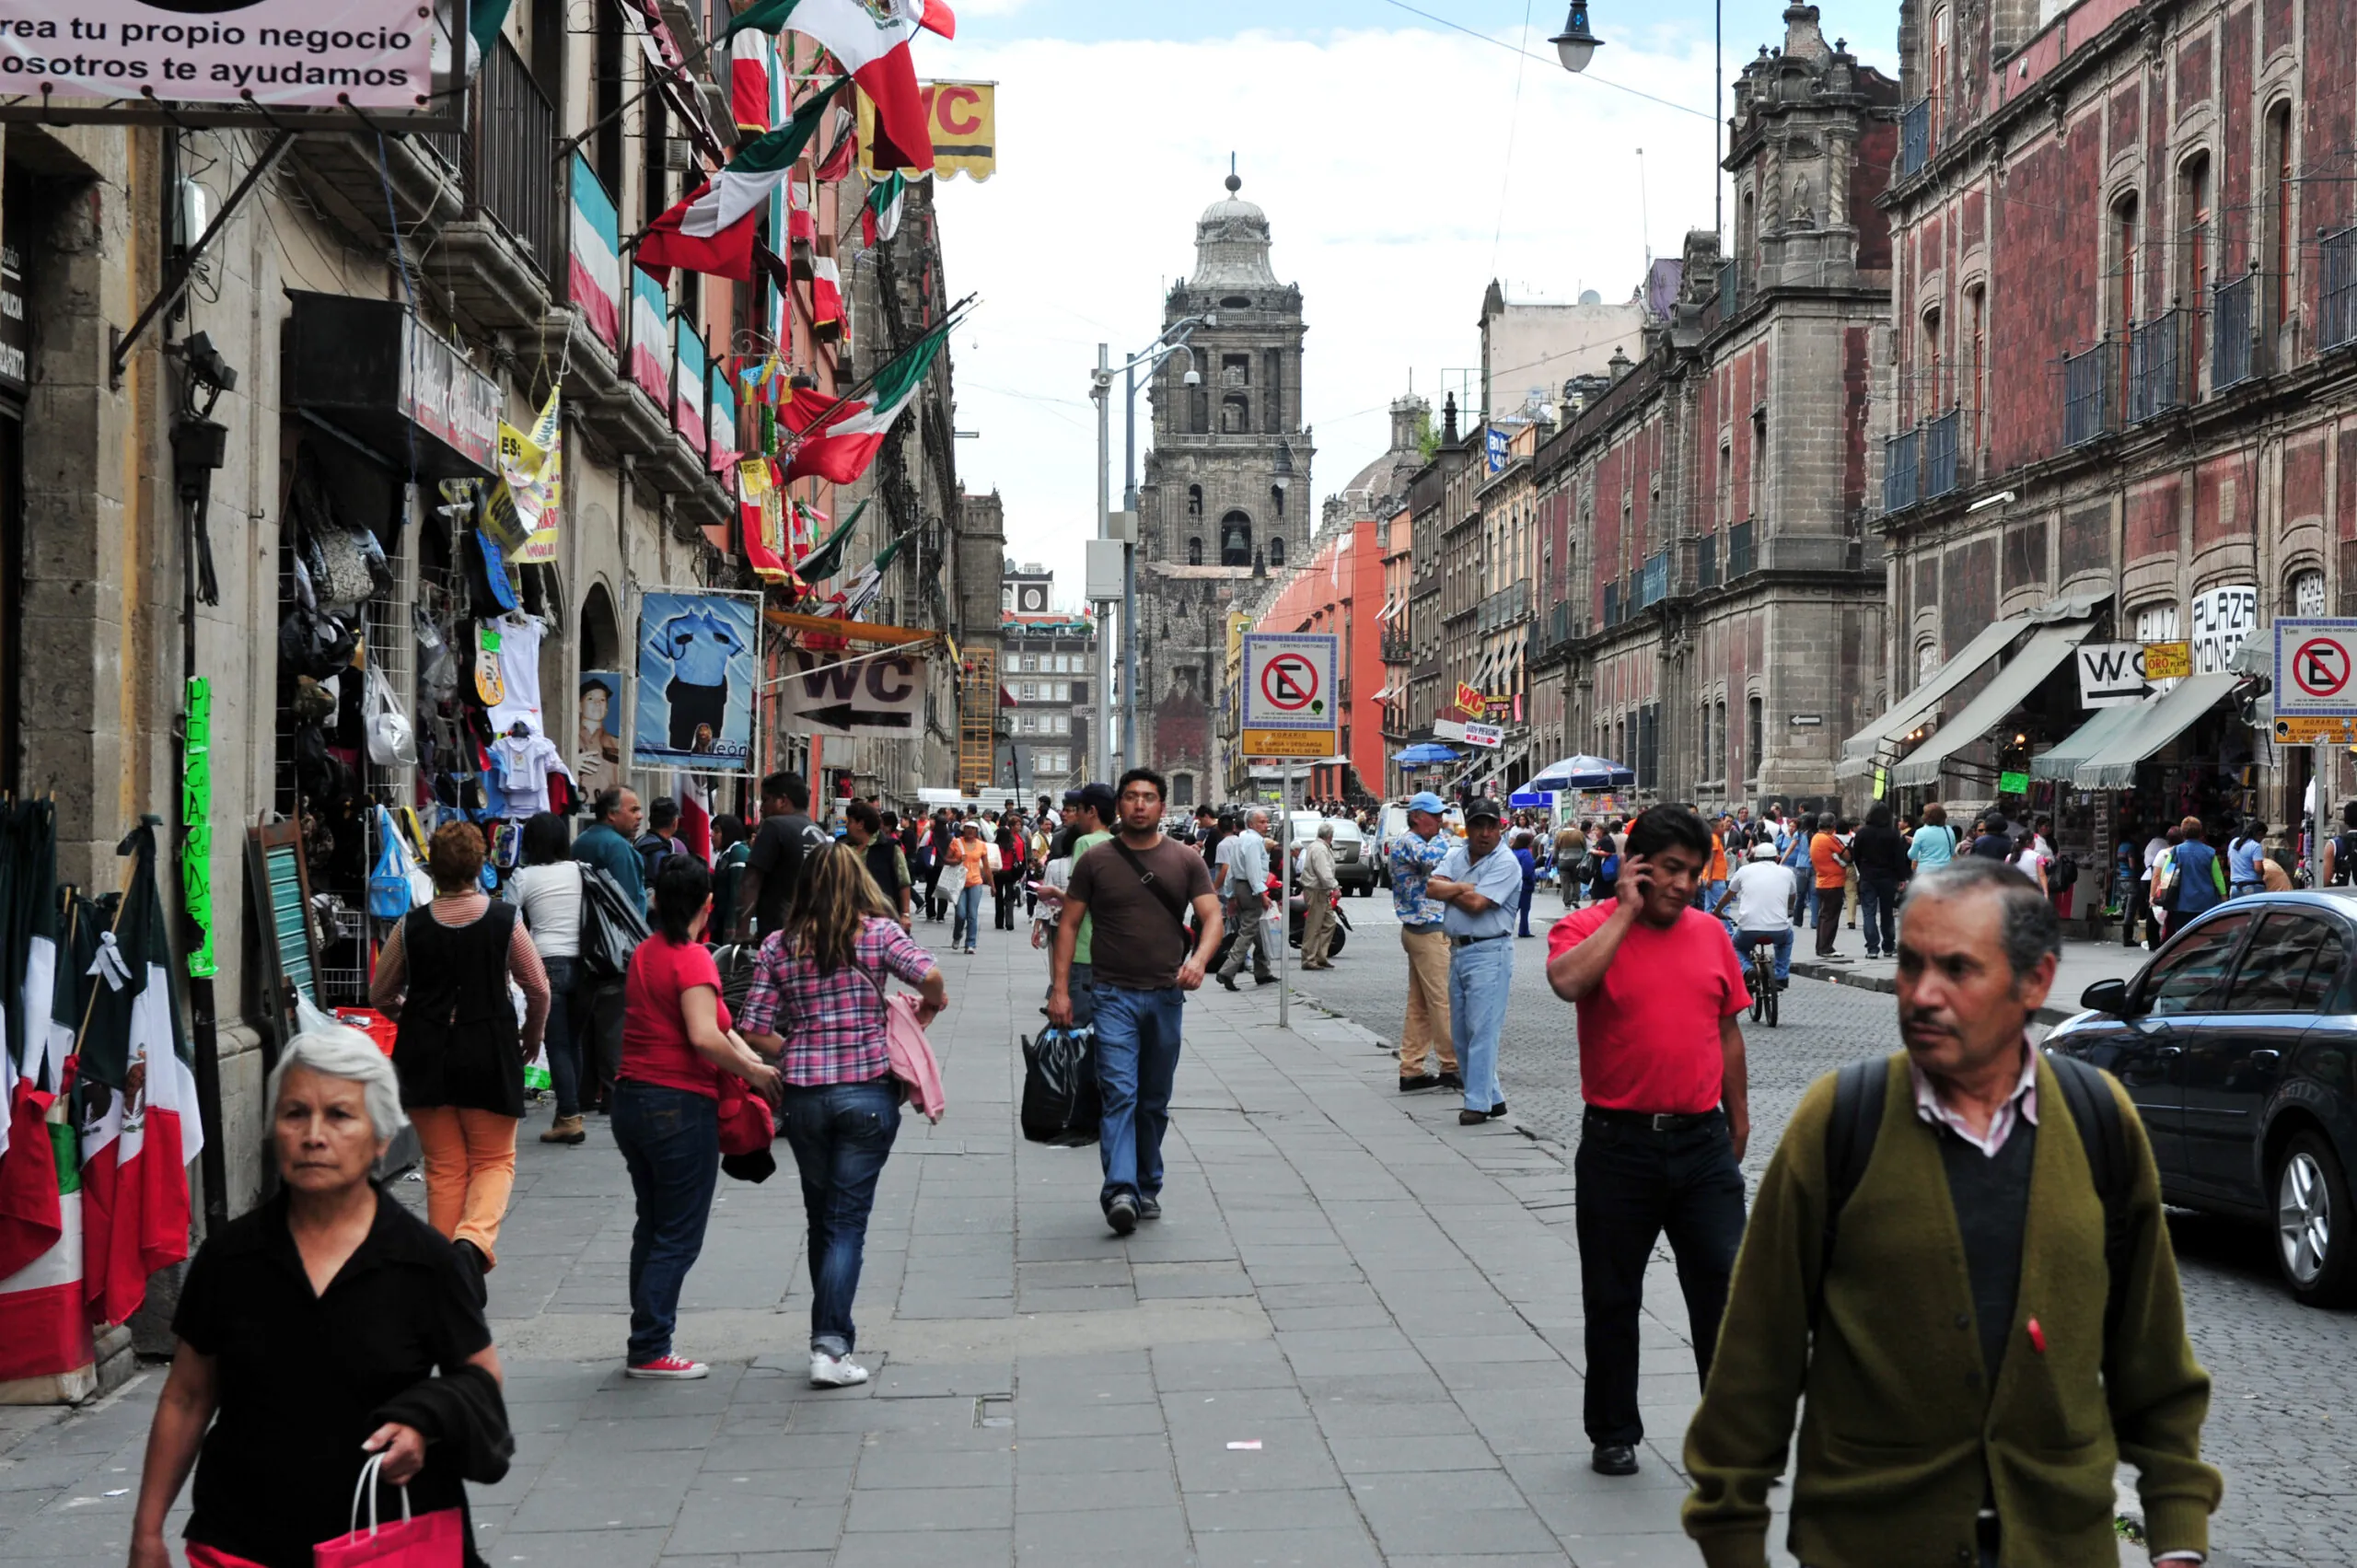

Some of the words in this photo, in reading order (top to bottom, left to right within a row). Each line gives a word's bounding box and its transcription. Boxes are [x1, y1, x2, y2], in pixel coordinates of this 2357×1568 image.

[70, 17, 107, 40] tu
[122, 21, 246, 49] propio
[260, 27, 412, 53] negocio
[2, 54, 148, 78] osotros
[162, 58, 196, 80] te
[210, 62, 408, 87] ayudamos
[921, 87, 981, 135] C
[2194, 592, 2256, 633] PLAZA
[2148, 657, 2168, 670] ORO
[2194, 633, 2243, 674] MONE
[2309, 649, 2334, 685] E
[797, 651, 913, 703] WC
[1277, 665, 1302, 699] E
[1458, 683, 1486, 712] WC
